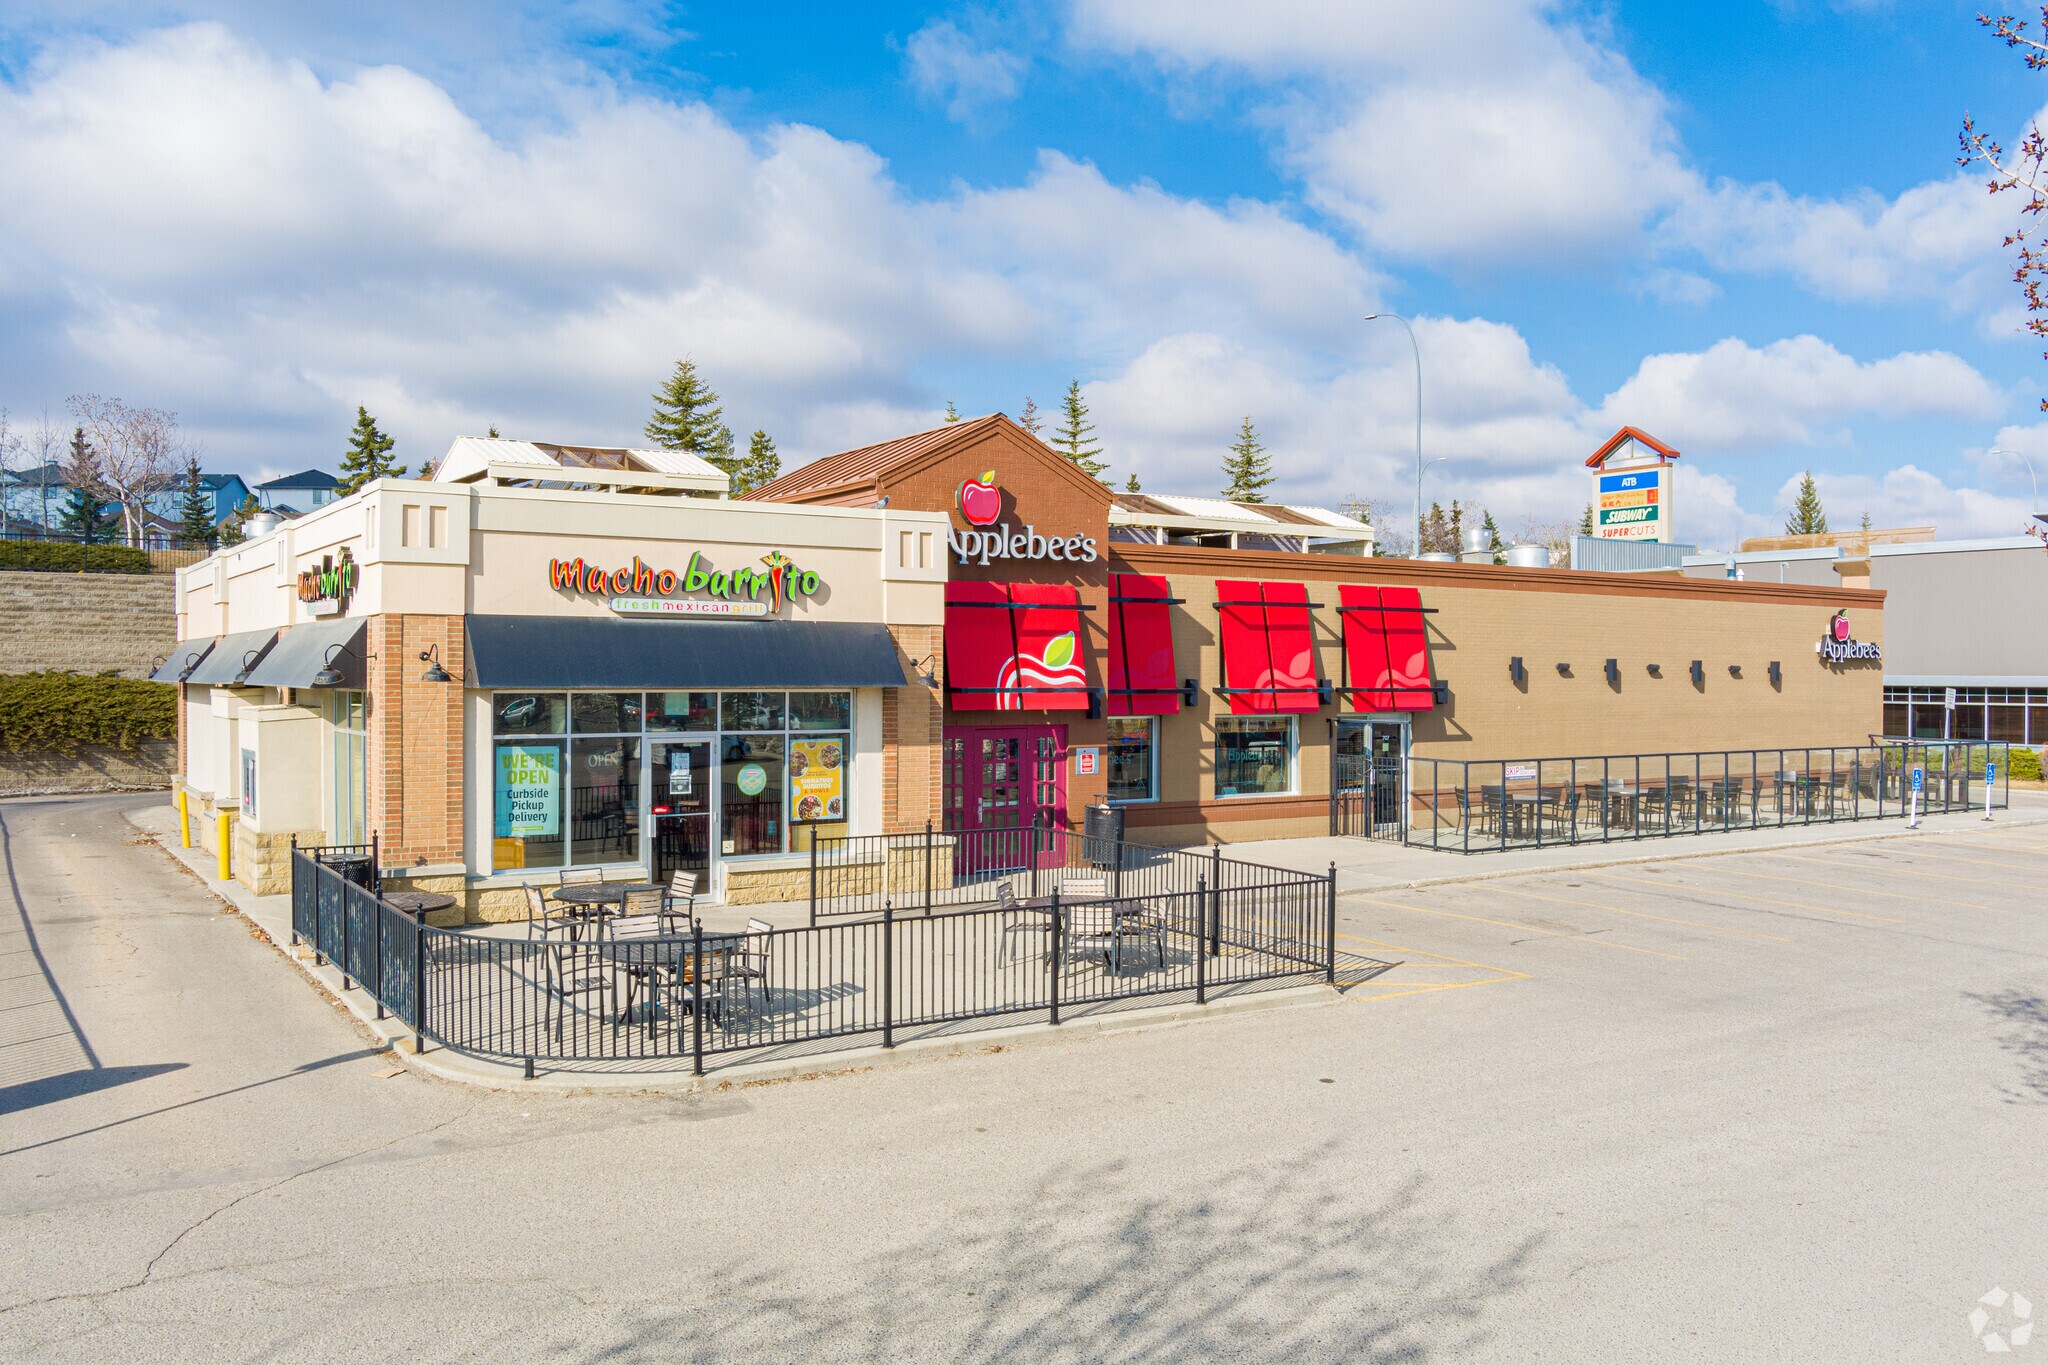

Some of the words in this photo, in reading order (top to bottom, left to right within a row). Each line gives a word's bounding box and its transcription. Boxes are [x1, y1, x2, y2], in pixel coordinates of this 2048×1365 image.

[1621, 477, 1637, 487] ATB
[1606, 507, 1652, 524] SUBWAY
[1602, 525, 1656, 538] SUPERCUTS
[501, 753, 555, 769] WE'RE
[588, 753, 619, 767] OPEN
[506, 769, 549, 785] OPEN
[1505, 766, 1520, 776] SKIP
[507, 788, 549, 799] Curbside
[512, 801, 544, 812] Pickup
[508, 812, 548, 823] Delivery
